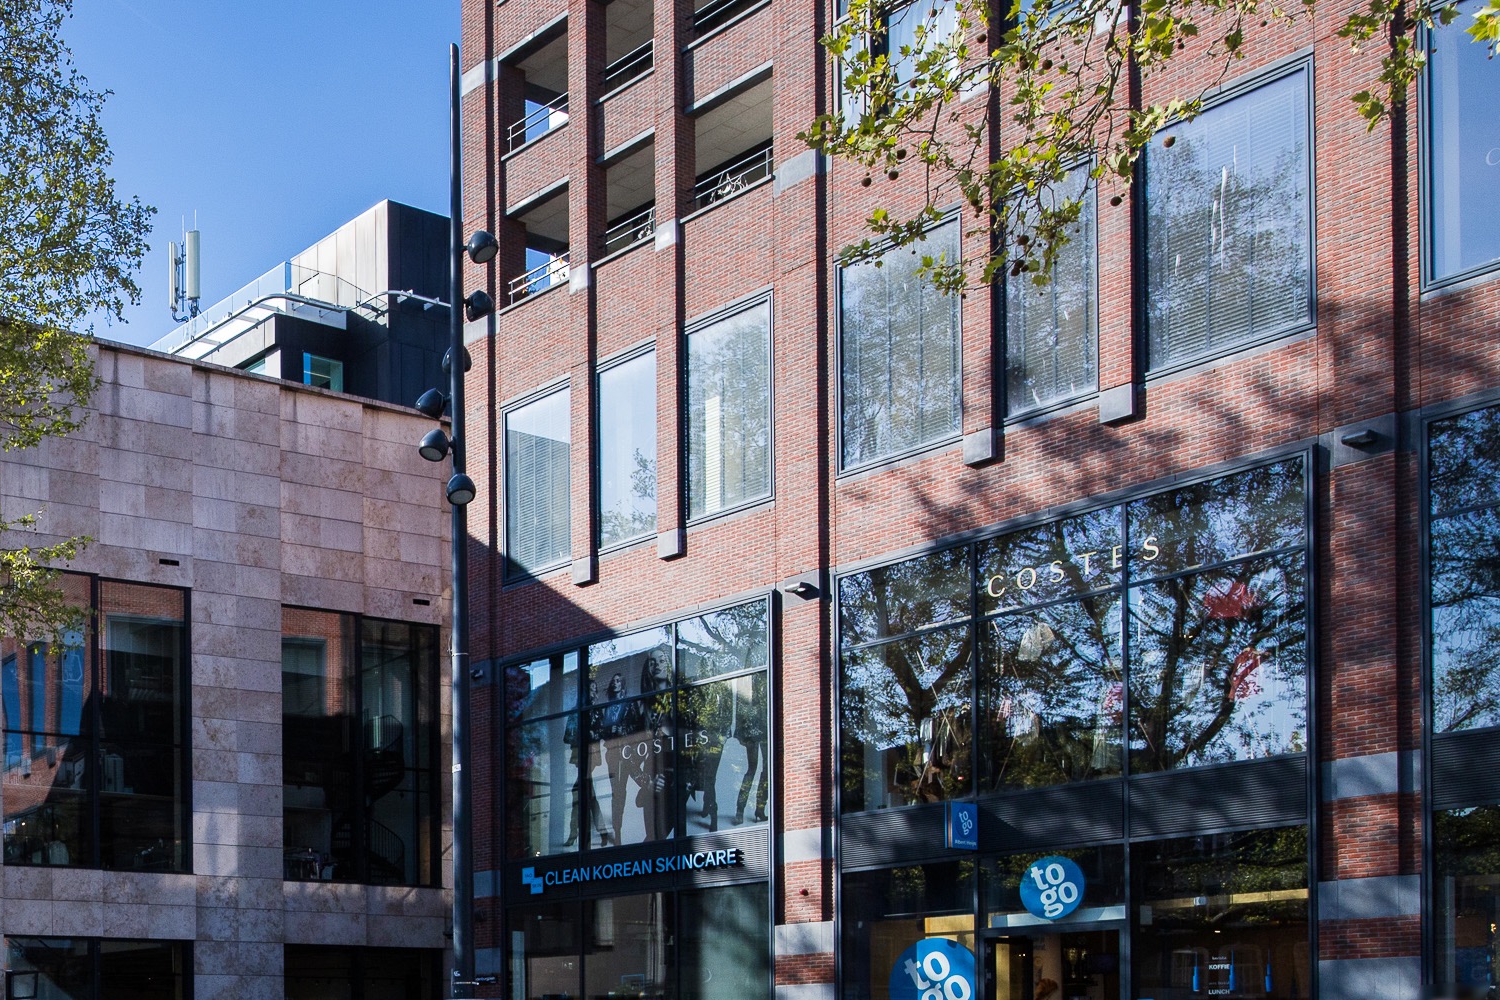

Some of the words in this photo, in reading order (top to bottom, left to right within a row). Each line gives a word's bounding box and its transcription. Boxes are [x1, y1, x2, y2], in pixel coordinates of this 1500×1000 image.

[987, 537, 1160, 598] COSTES
[621, 729, 709, 760] COSTES
[545, 867, 590, 886] CLEAN
[593, 859, 652, 880] KOREAN
[655, 848, 738, 873] SKINCARE
[1030, 863, 1066, 891] to
[1040, 881, 1079, 918] go
[904, 950, 951, 991] to
